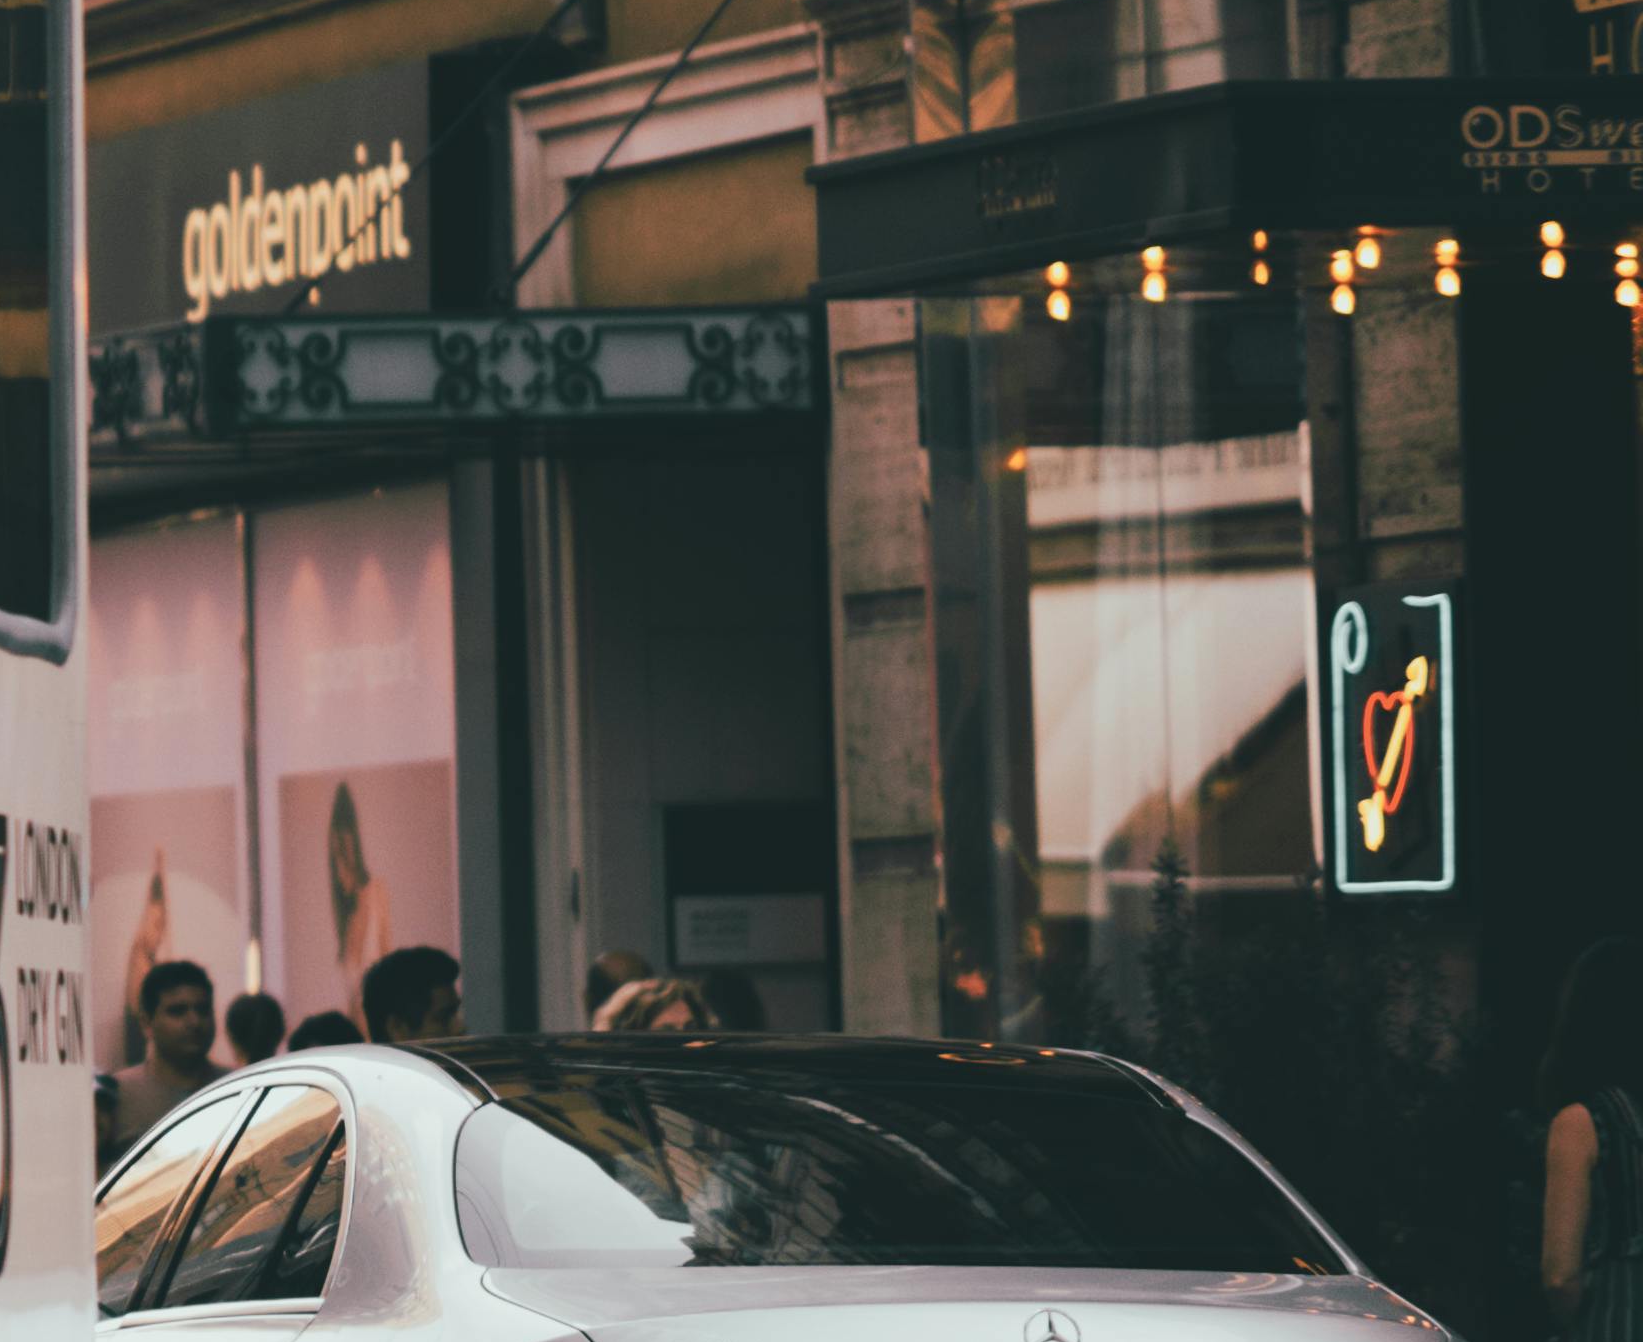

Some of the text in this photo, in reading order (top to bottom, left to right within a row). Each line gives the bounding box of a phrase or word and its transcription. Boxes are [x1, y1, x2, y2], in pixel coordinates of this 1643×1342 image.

[182, 139, 411, 325] goldenpoint
[15, 818, 83, 925] LONDON
[17, 966, 51, 1064] DRY
